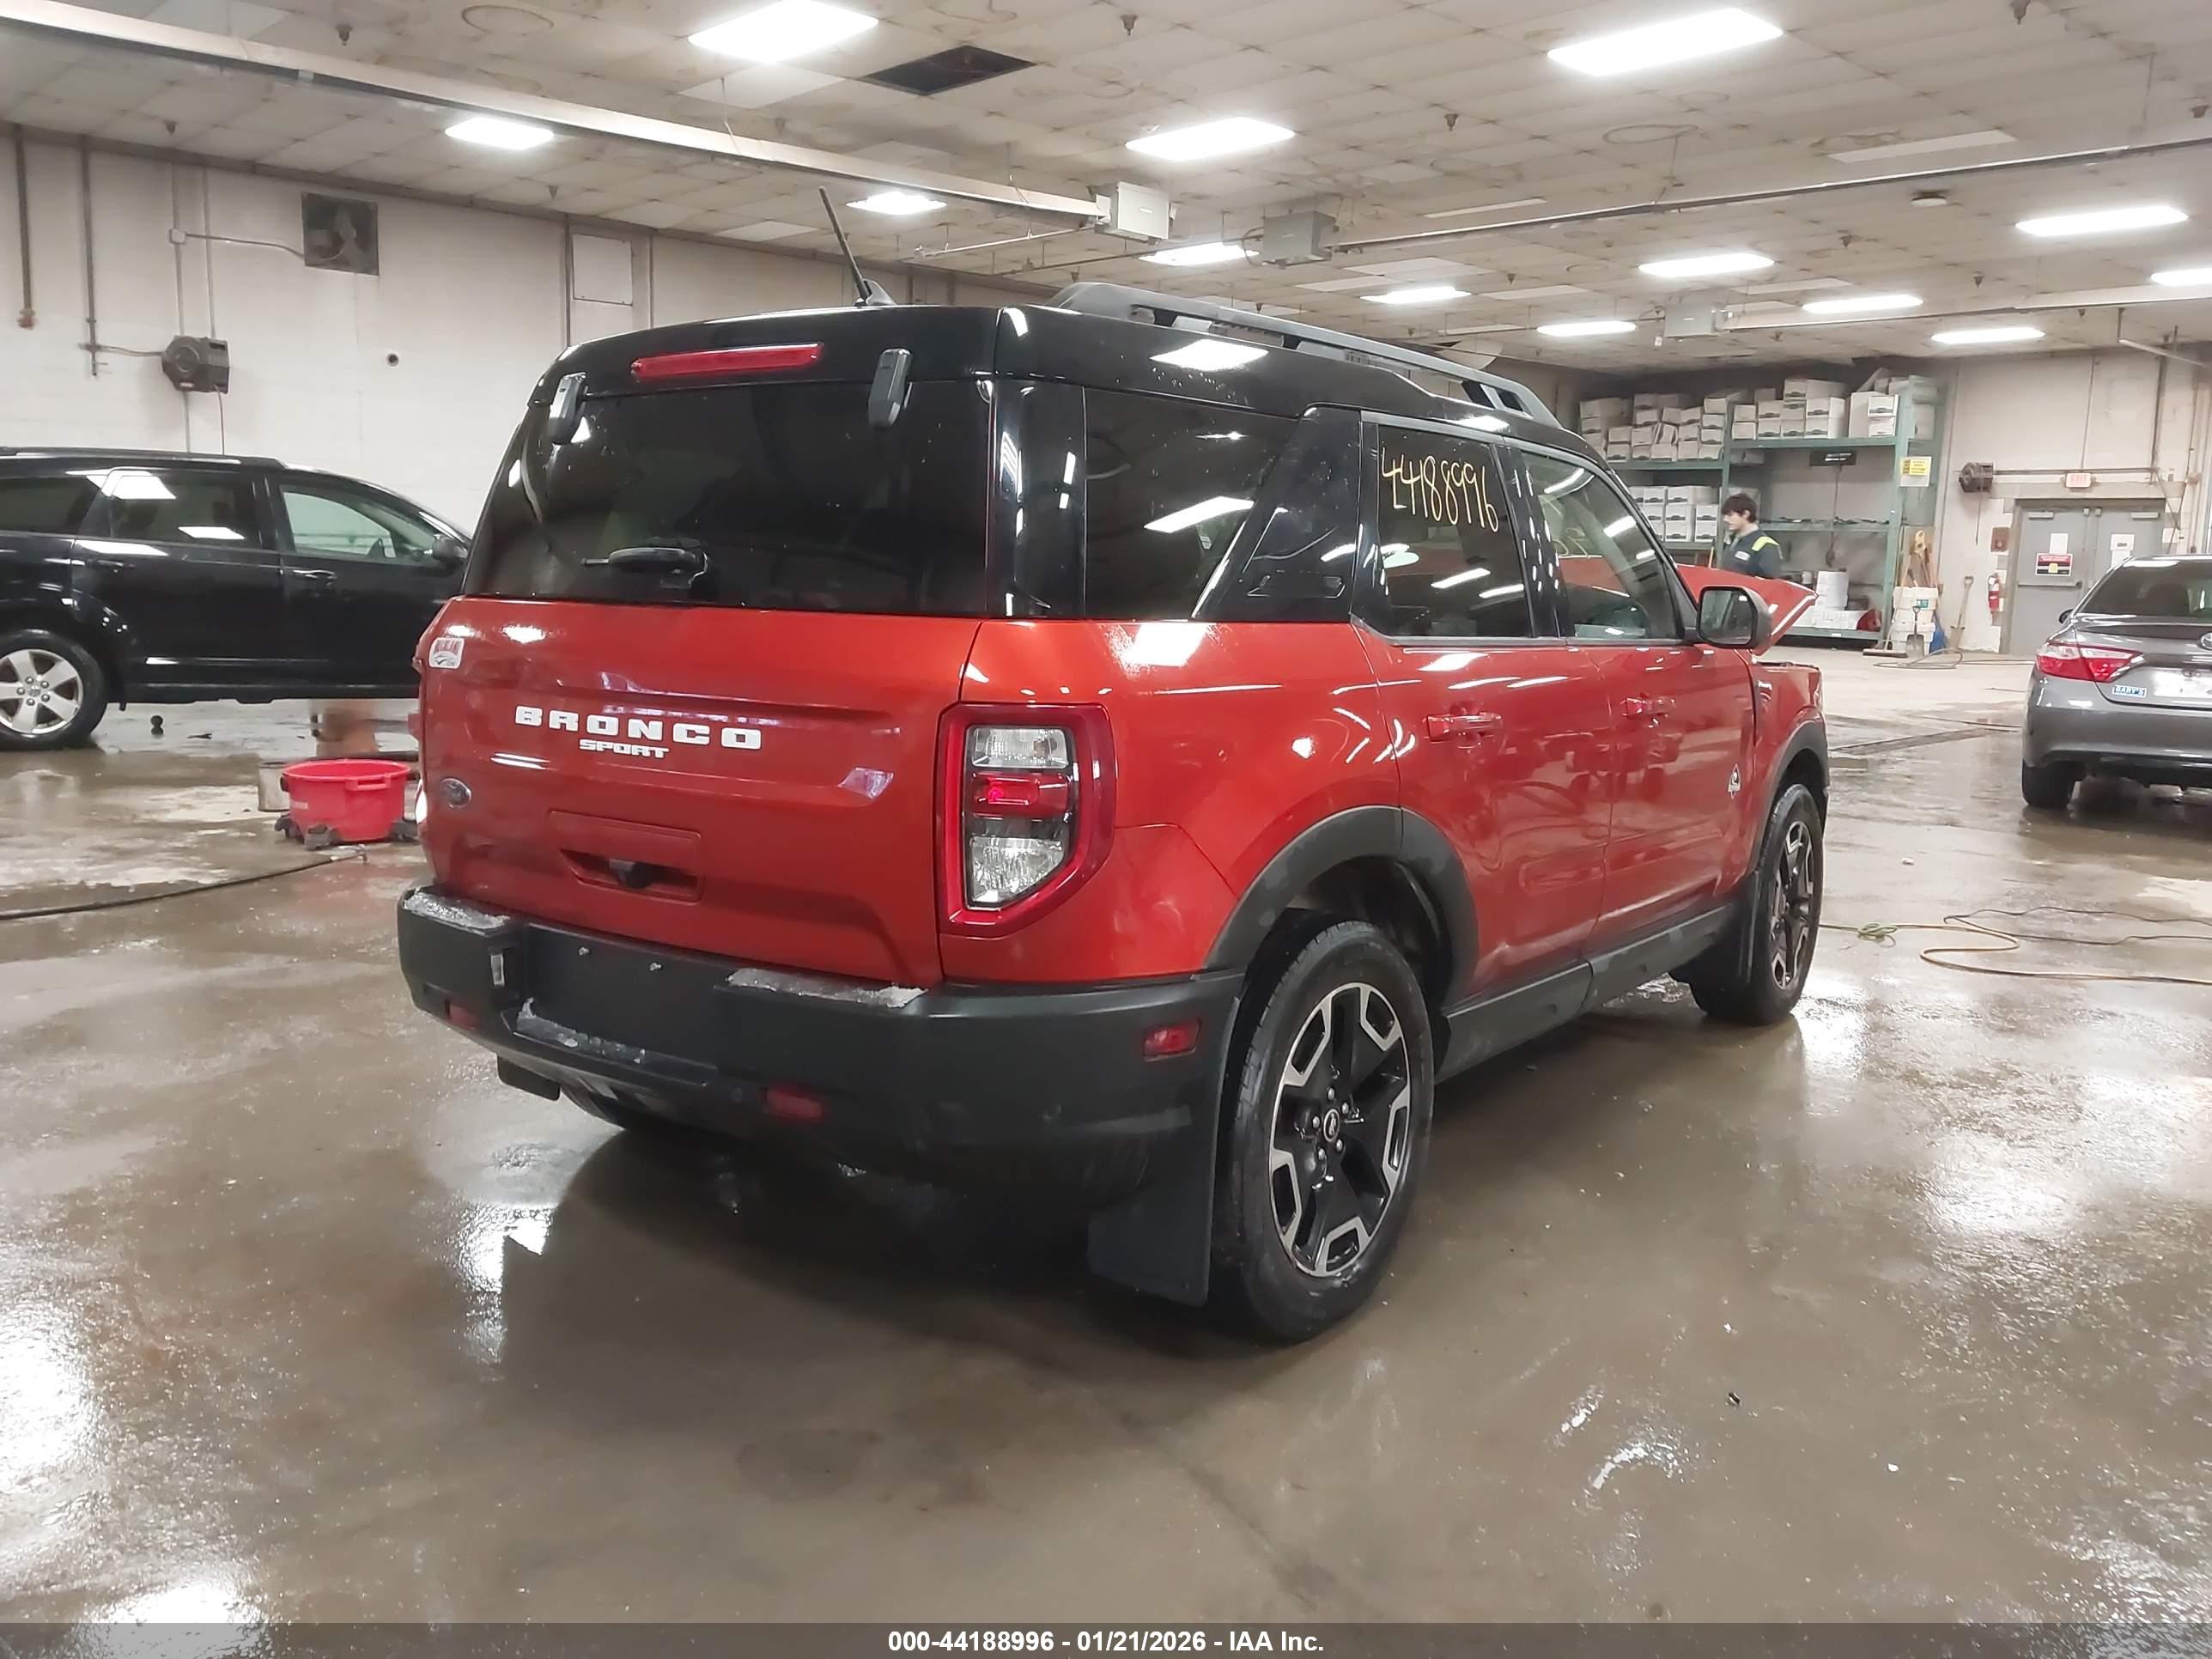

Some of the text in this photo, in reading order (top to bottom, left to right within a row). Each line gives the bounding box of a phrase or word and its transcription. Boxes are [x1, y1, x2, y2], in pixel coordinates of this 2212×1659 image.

[1381, 446, 1499, 533] 44188996
[514, 705, 762, 750] BRONCO
[579, 738, 670, 759] SPORT
